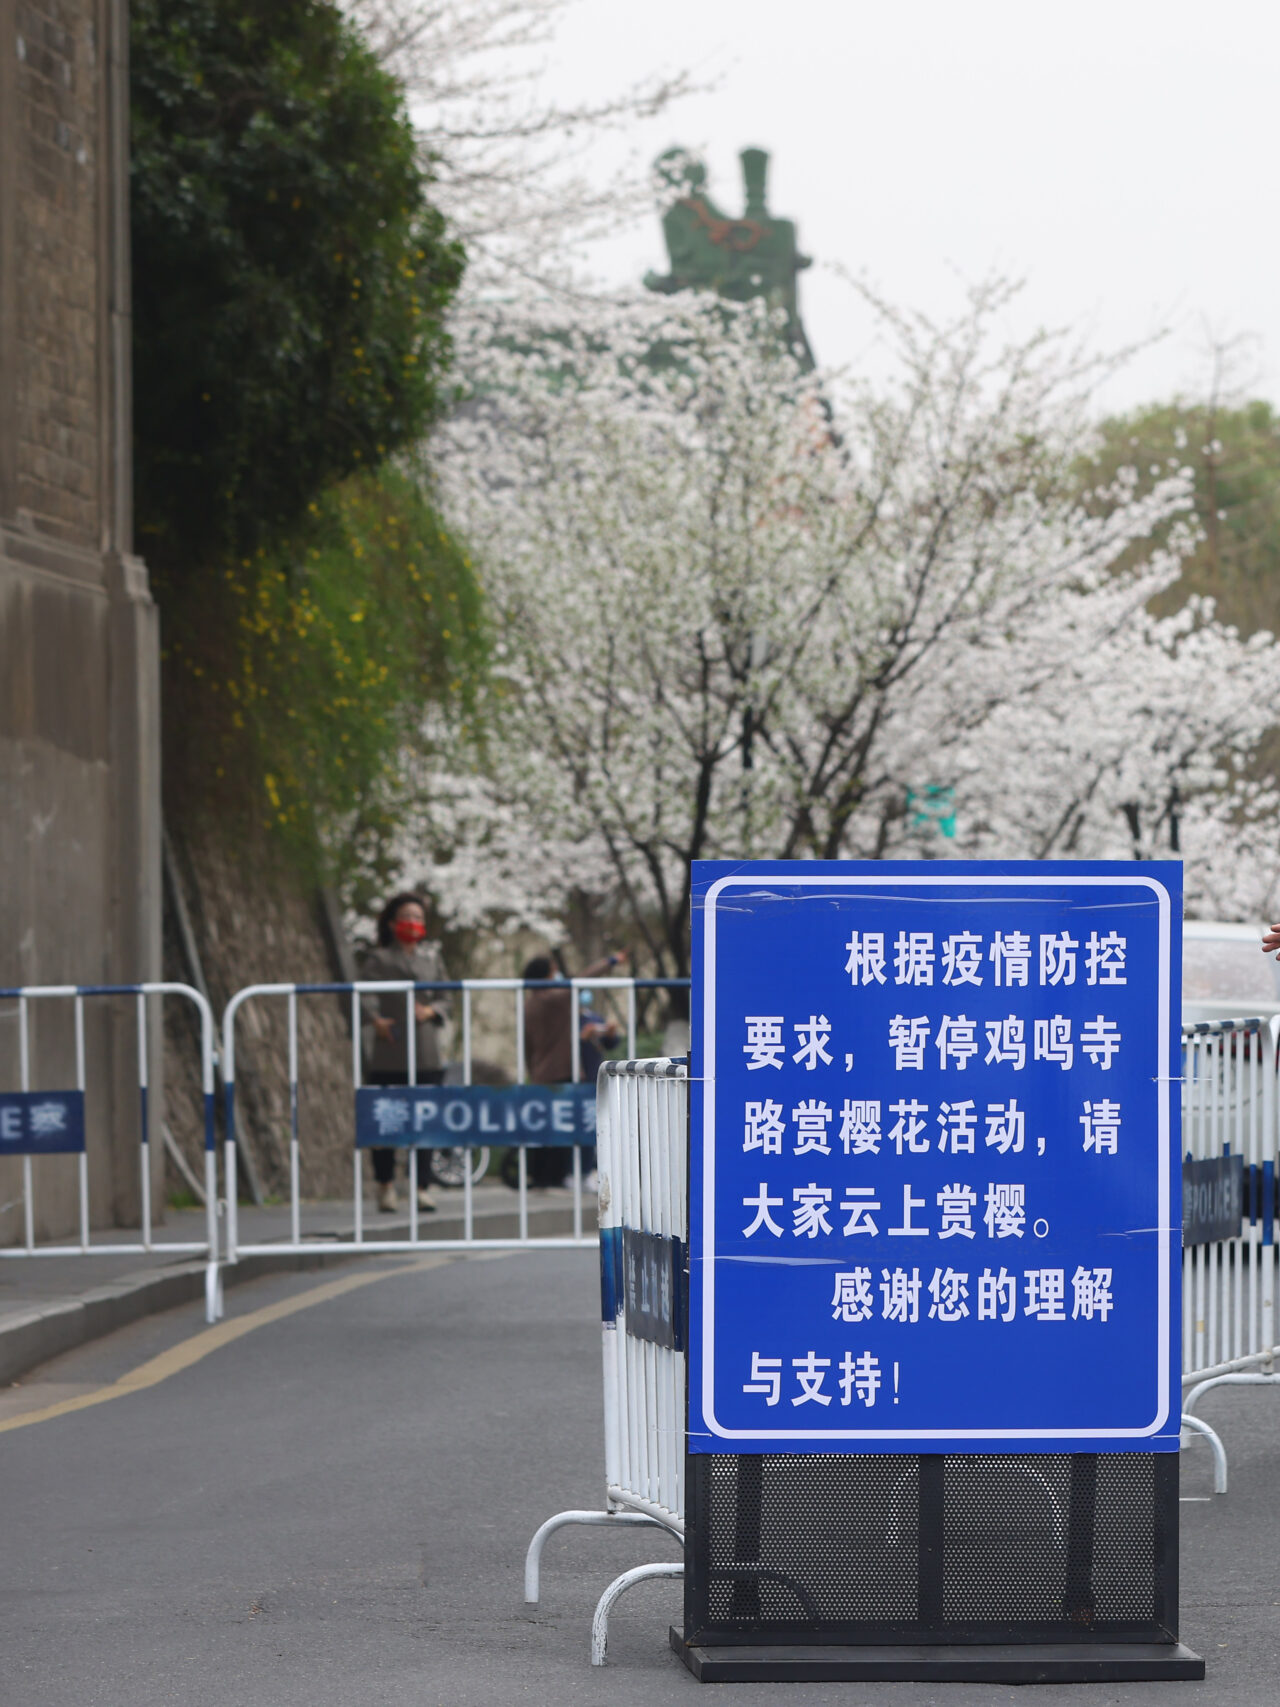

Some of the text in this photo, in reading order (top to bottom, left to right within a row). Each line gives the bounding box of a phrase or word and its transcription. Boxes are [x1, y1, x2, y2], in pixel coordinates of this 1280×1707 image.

[845, 930, 1128, 987] 根据疫情防控
[742, 1013, 1122, 1072] 要求，暂停鸡鸣寺
[413, 1100, 576, 1133] POLICE
[742, 1098, 1122, 1157] 路赏樱花活动，请
[741, 1182, 1049, 1240] 大家云上赏樱。
[831, 1266, 1114, 1324] 感谢您的理解
[742, 1350, 899, 1408] 与支持！
